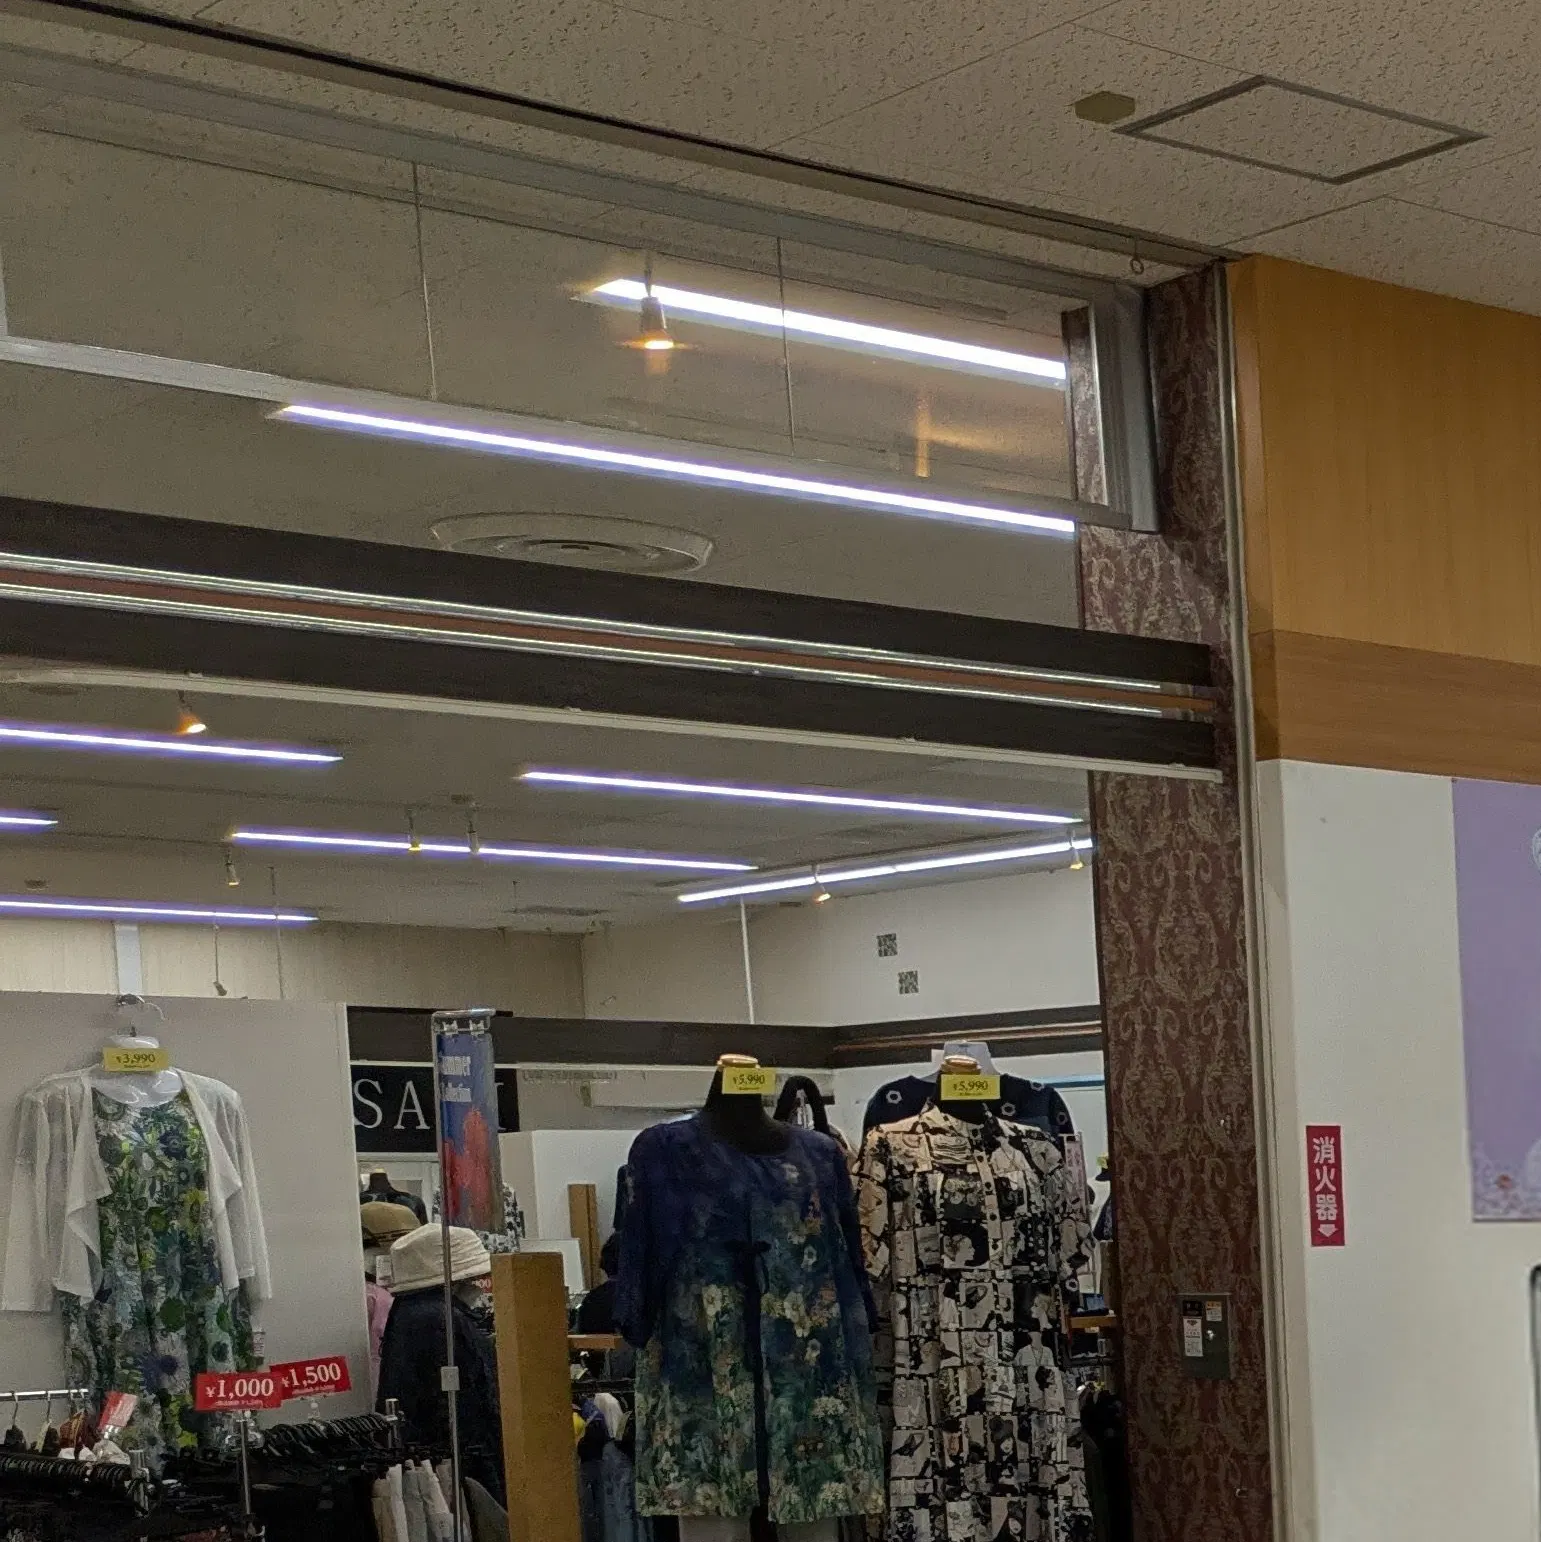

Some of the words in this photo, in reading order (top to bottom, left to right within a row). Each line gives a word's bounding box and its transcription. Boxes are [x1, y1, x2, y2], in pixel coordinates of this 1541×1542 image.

[732, 1072, 766, 1087] ¥5,990
[1312, 1135, 1339, 1222] 消火器
[281, 1362, 342, 1388] ¥1,500
[205, 1378, 274, 1399] ¥1,000
